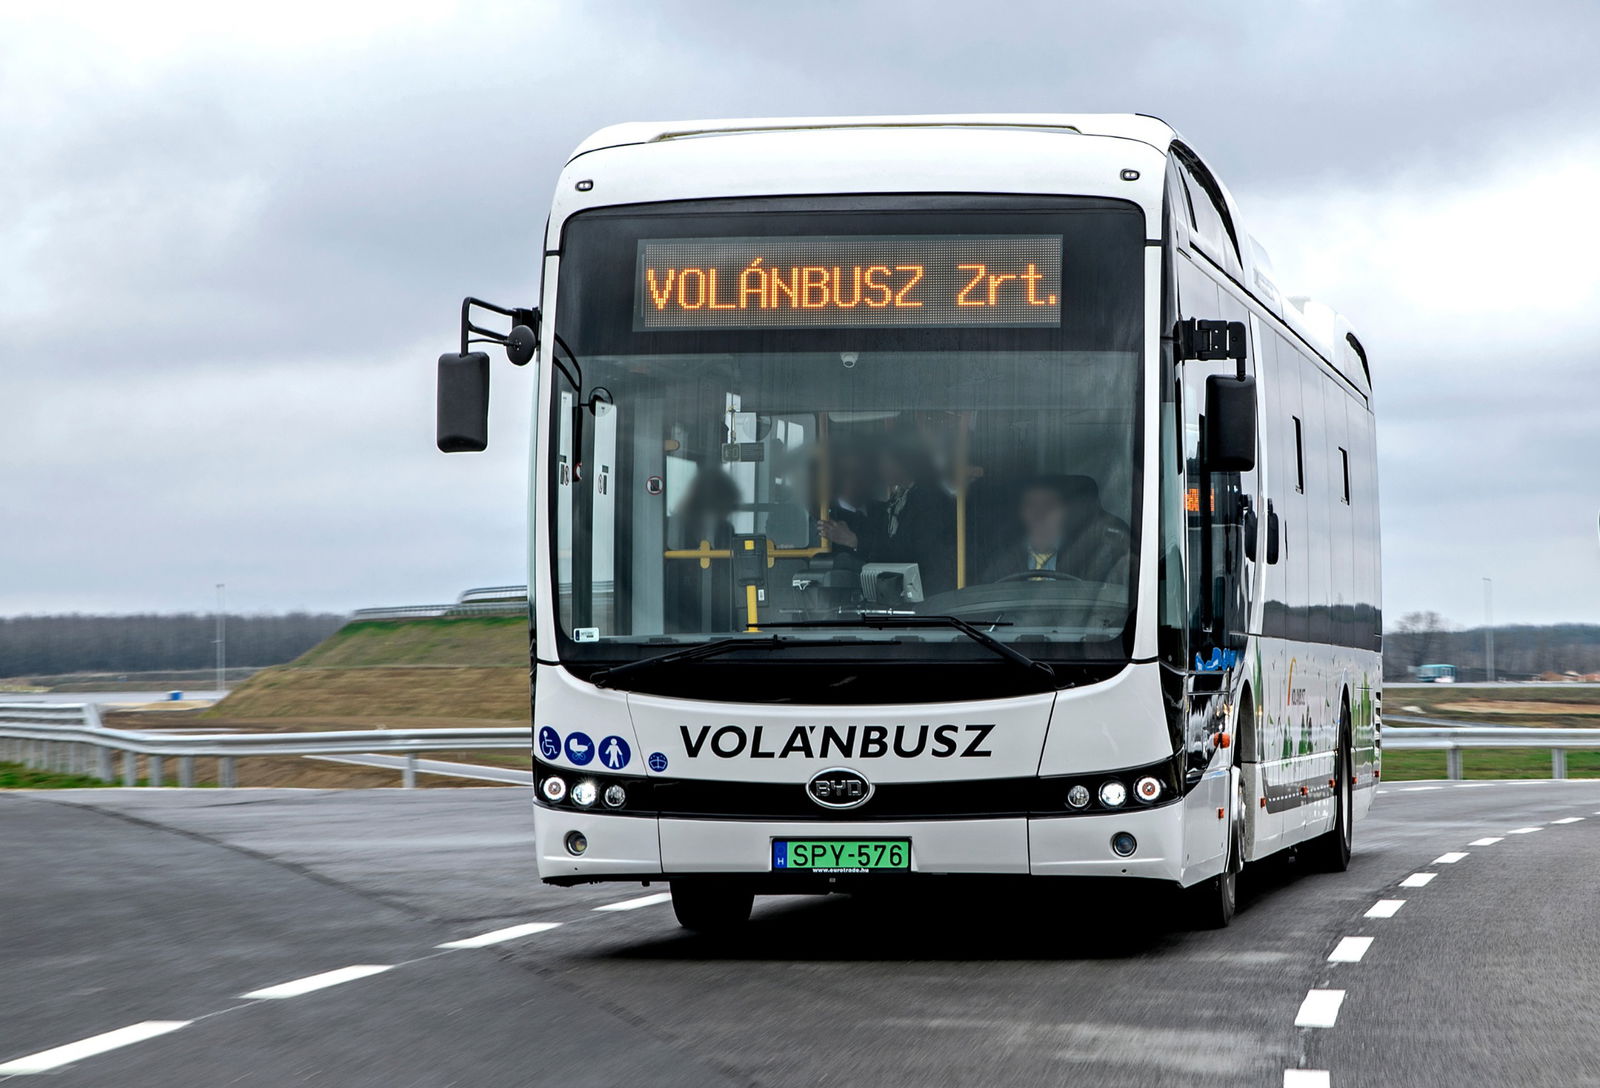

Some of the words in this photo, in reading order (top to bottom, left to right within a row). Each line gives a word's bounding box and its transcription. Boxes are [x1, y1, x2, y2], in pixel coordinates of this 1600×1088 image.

[646, 257, 925, 310] VOLÁNBUSZ
[956, 263, 1058, 306] Zrt.
[679, 724, 997, 759] VOLÁNBUSZ
[815, 780, 862, 796] BYD
[777, 857, 785, 866] H
[792, 844, 903, 867] SPY-576
